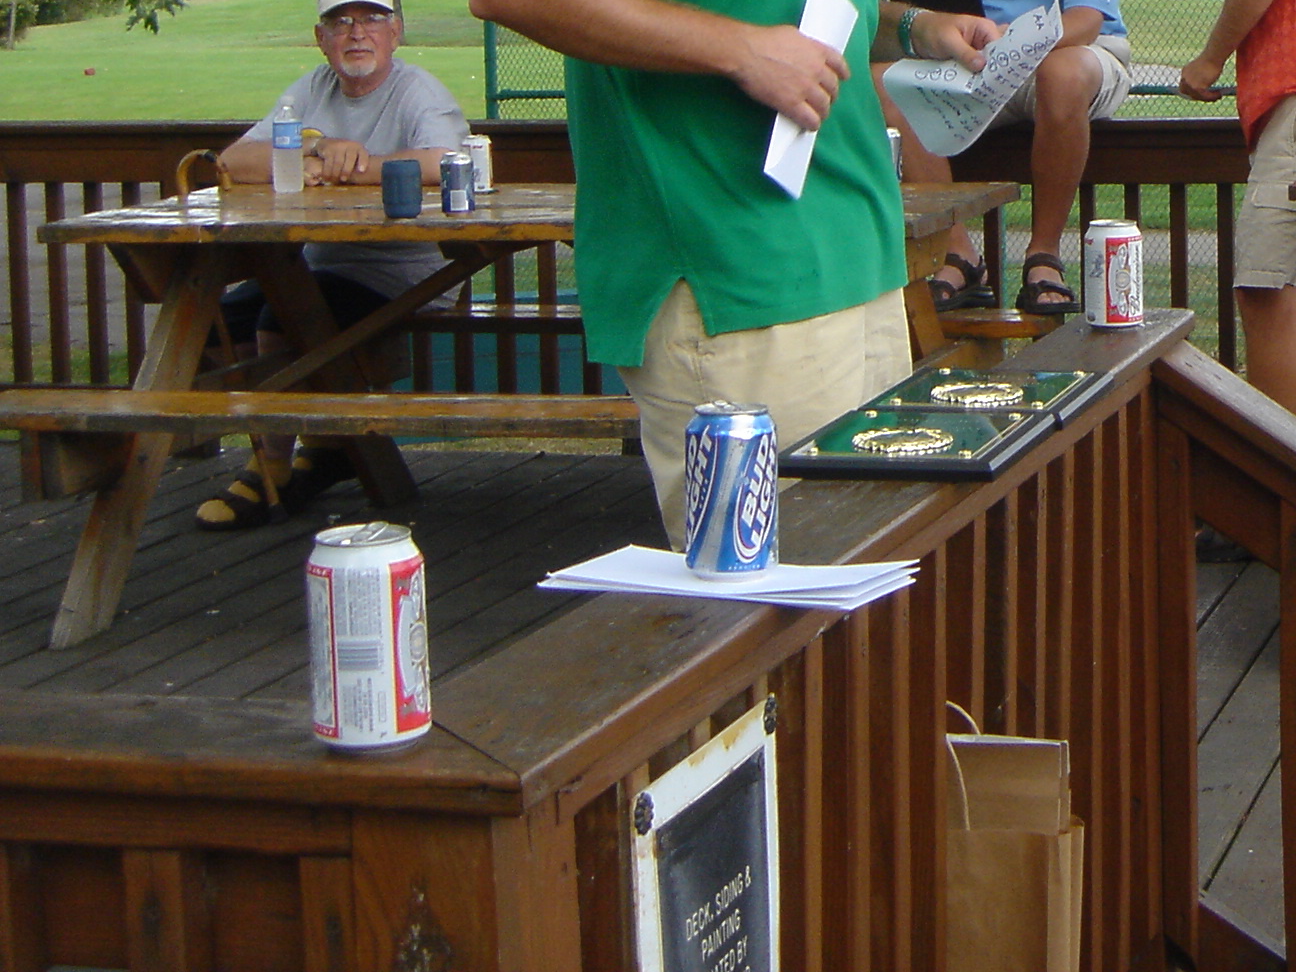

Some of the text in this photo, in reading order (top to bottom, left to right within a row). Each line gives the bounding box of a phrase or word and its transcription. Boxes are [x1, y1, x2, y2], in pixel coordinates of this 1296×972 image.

[741, 433, 769, 528] BUD
[715, 872, 744, 915] SIDING
[744, 865, 752, 888] &
[701, 908, 741, 962] PAINTING
[737, 935, 748, 964] BY
